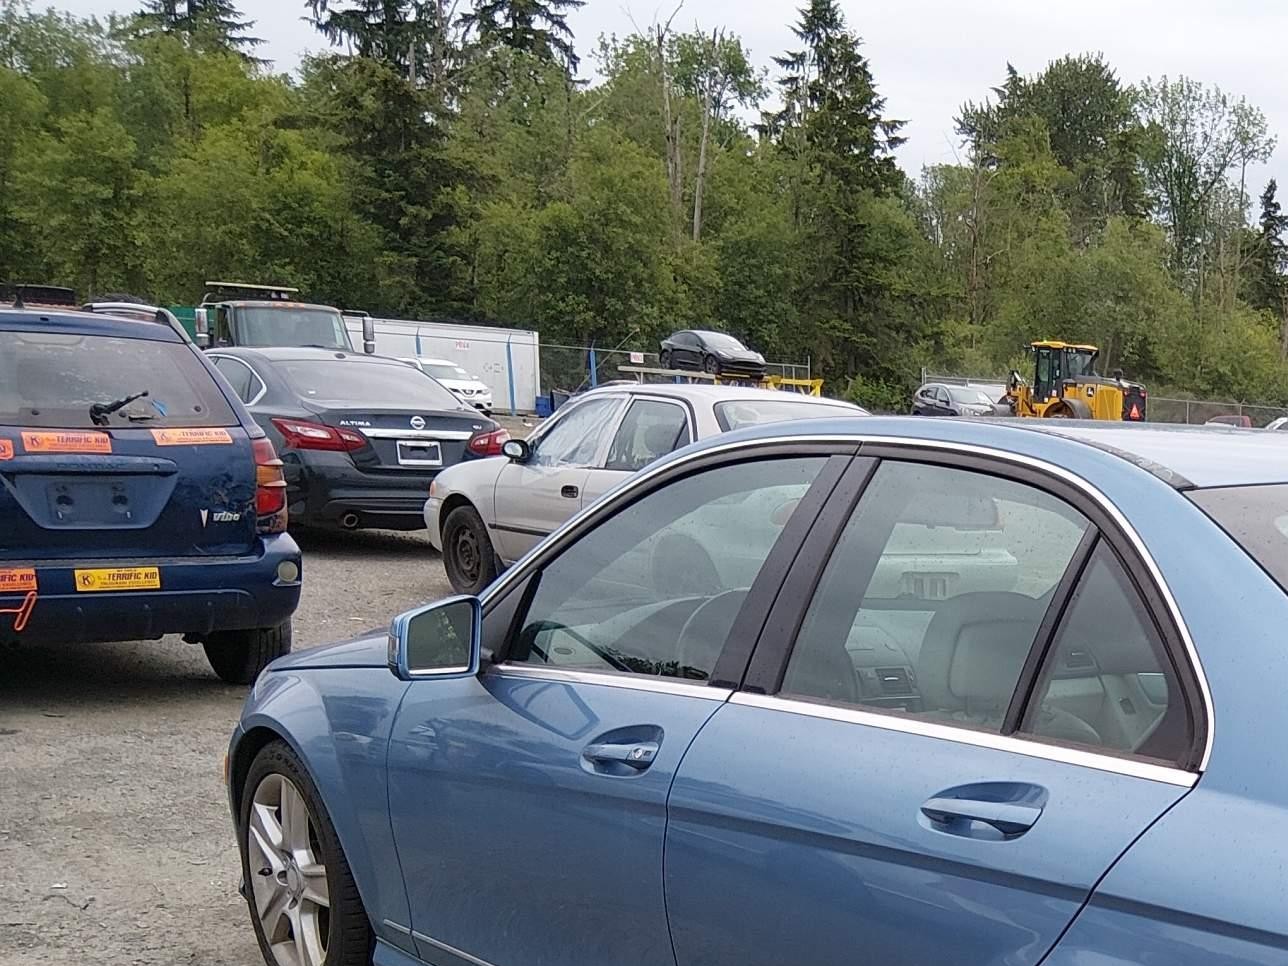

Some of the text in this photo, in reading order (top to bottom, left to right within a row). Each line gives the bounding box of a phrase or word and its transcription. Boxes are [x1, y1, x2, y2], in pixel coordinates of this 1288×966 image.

[339, 419, 371, 427] ALTIMA
[107, 572, 142, 581] TERRIFIC
[143, 571, 158, 580] KID
